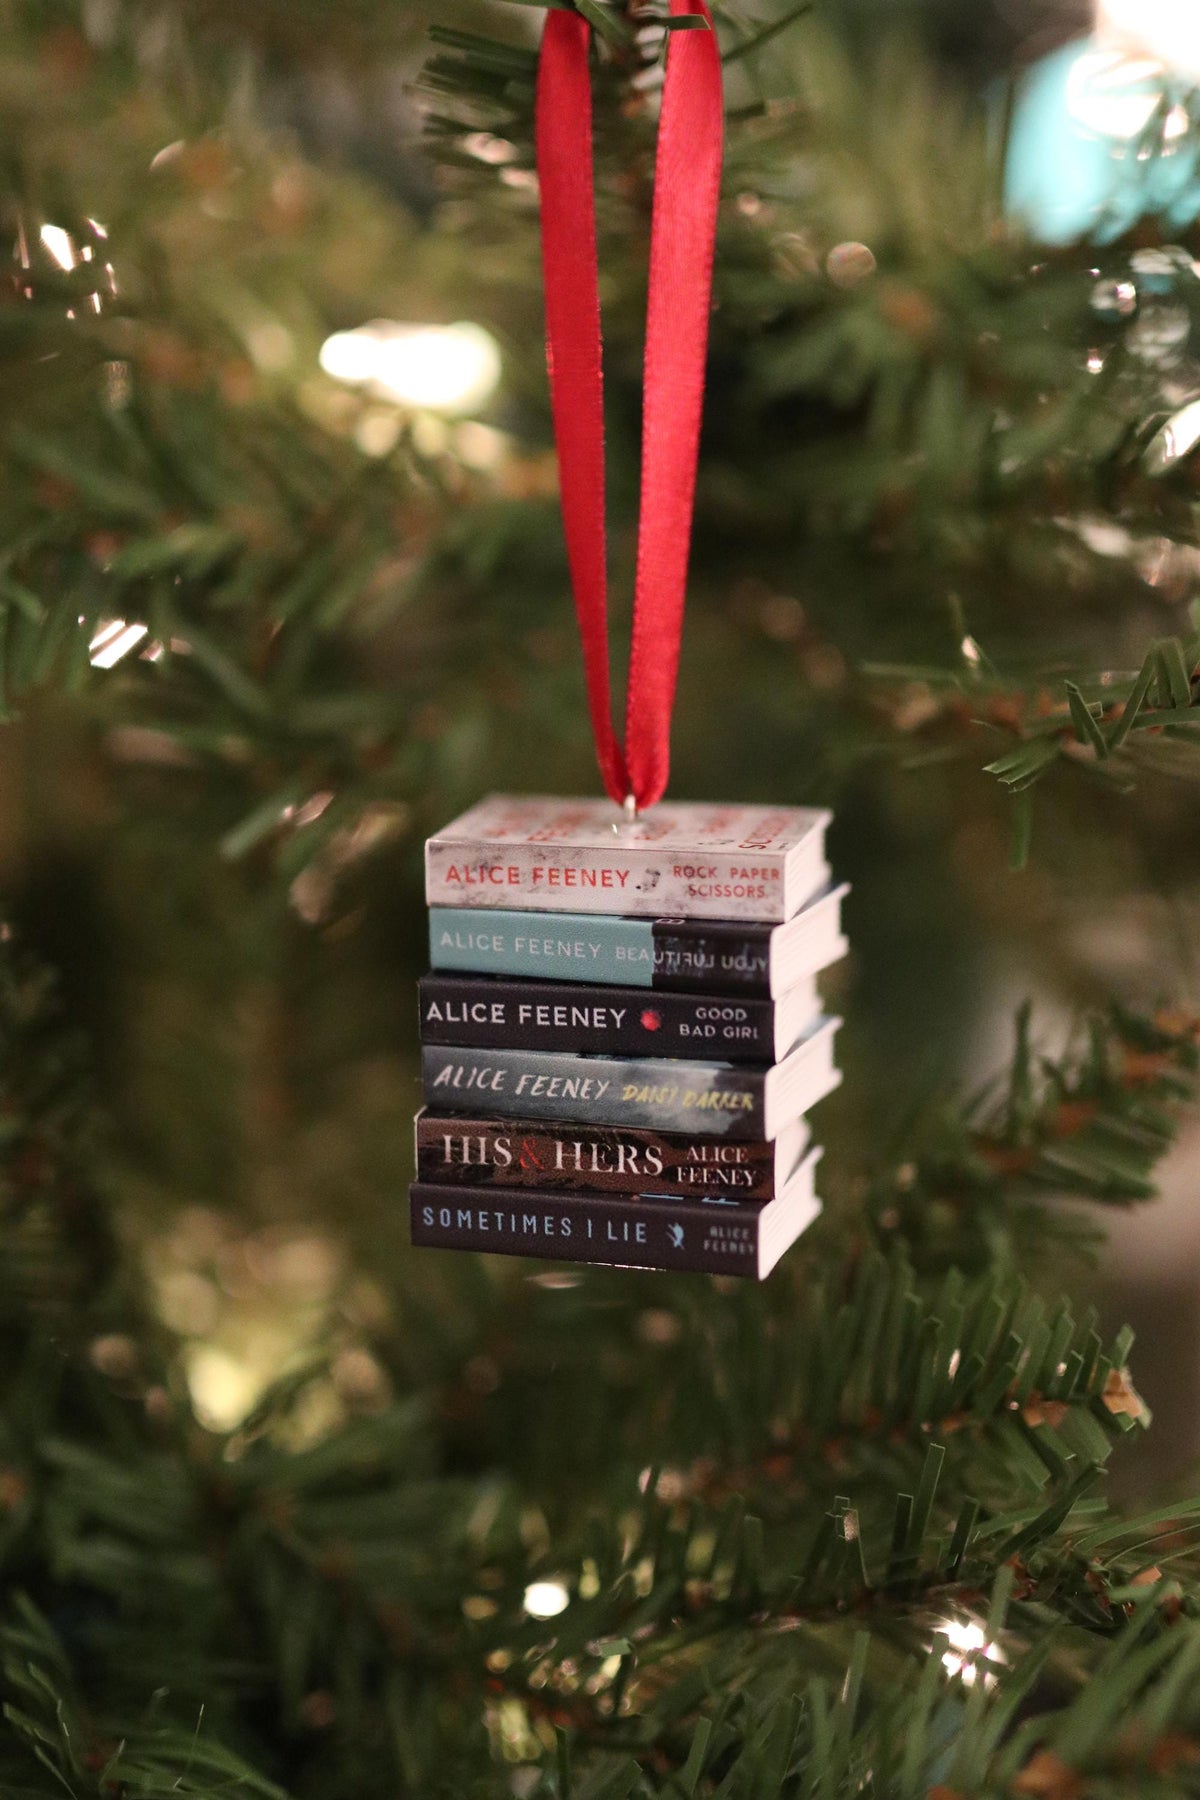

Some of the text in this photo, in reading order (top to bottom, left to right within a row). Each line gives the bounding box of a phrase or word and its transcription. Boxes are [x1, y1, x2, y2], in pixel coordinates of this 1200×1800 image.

[445, 864, 631, 889] ALICE FEENEY
[672, 865, 780, 881] ROCK PAPER
[687, 884, 766, 899] SCISSORS
[440, 931, 505, 953] ALICE
[514, 937, 602, 959] FEENEY
[425, 1001, 627, 1029] ALICE FEENEY
[695, 1006, 748, 1022] GOOD
[678, 1023, 760, 1040] BAD GIRL
[432, 1064, 756, 1111] ALICE FEENEY DAISY DARKER
[441, 1134, 665, 1177] HIS & HERS
[685, 1144, 750, 1164] ALICE
[676, 1165, 758, 1188] FEENEY
[422, 1205, 648, 1244] SOMETIMES I LIE
